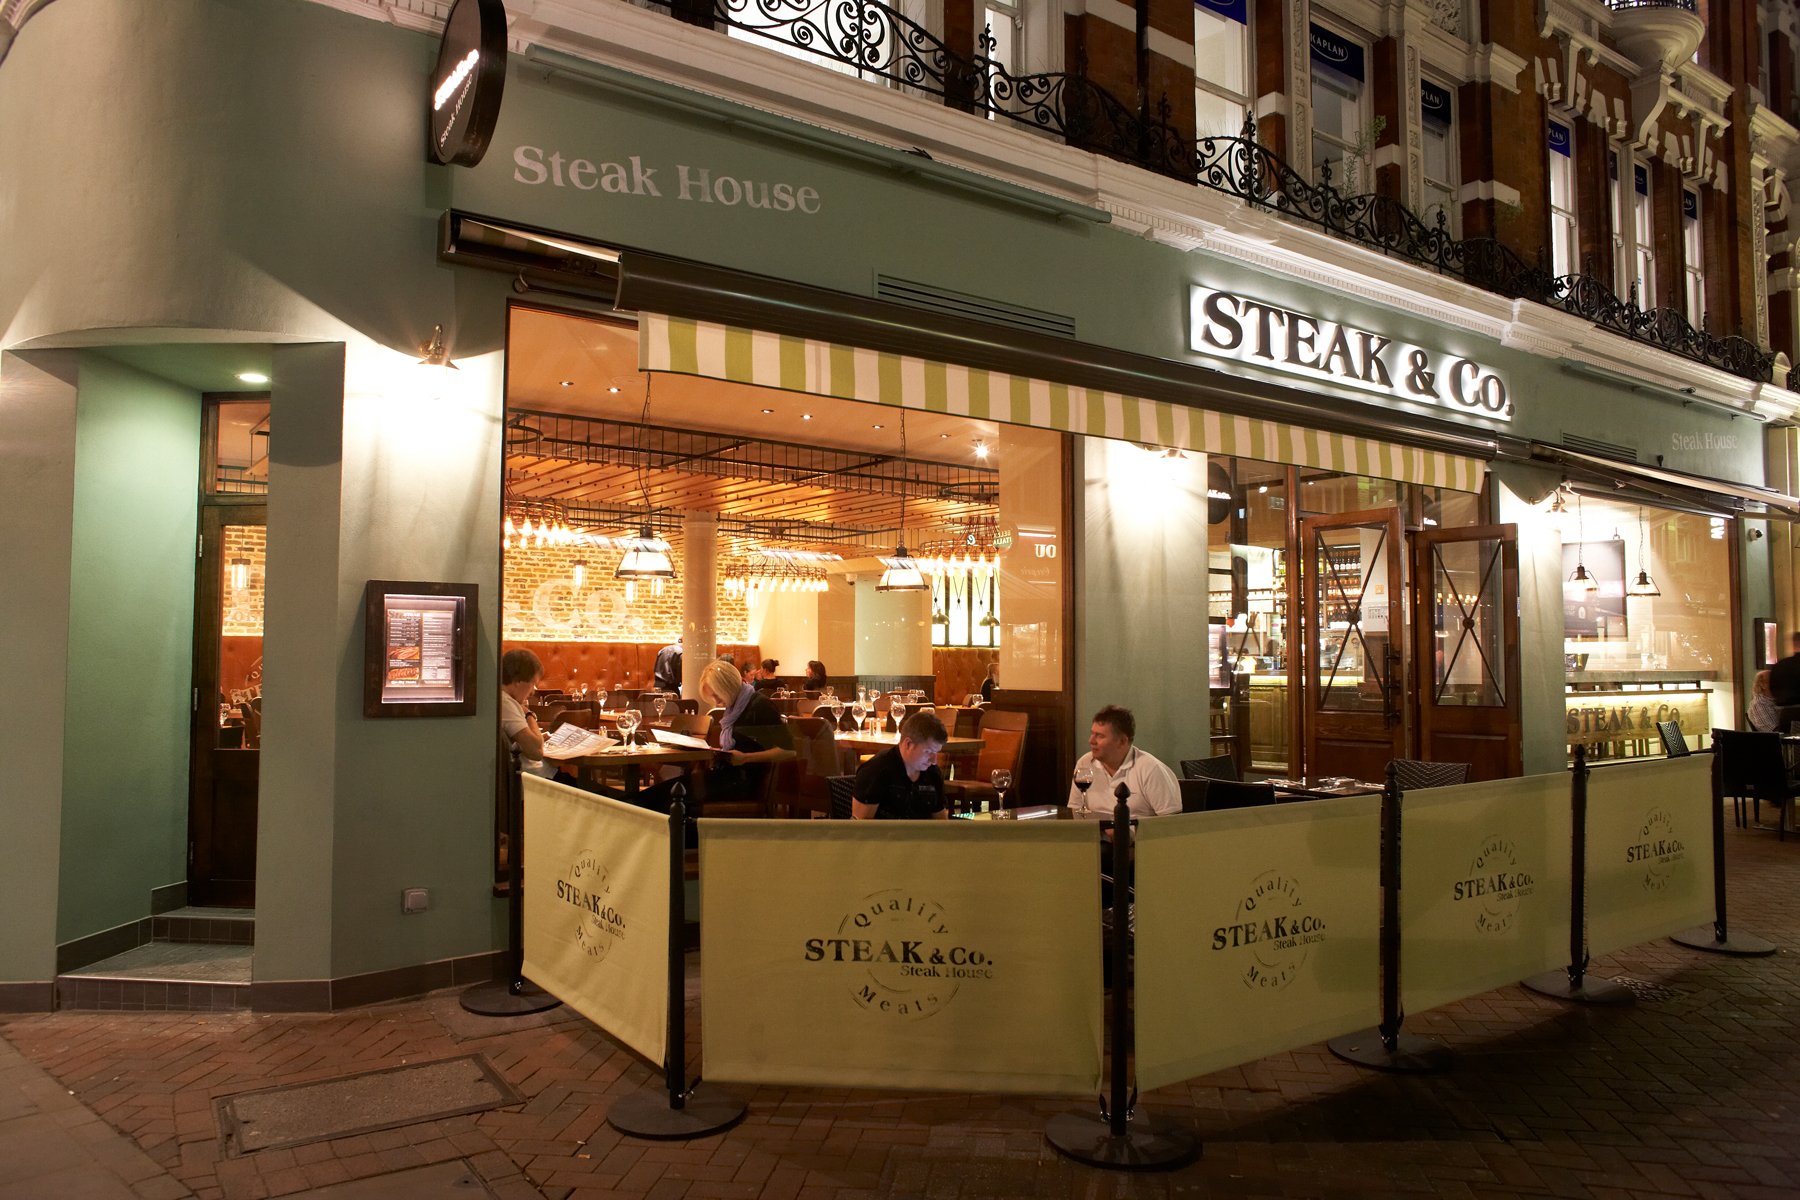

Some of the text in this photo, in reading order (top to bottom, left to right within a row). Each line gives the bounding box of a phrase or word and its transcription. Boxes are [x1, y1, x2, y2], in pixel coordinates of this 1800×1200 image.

[1311, 33, 1344, 57] KAPLAN
[513, 145, 822, 214] Steak House
[1201, 292, 1393, 389] STEAK
[1405, 349, 1440, 399] &
[1671, 432, 1738, 451] Steak House
[1567, 706, 1634, 734] STEAK
[1640, 707, 1652, 728] &
[1245, 876, 1302, 911] Quality
[854, 898, 949, 935] Quality
[900, 964, 941, 978] Steak
[858, 985, 938, 1015] Meats
